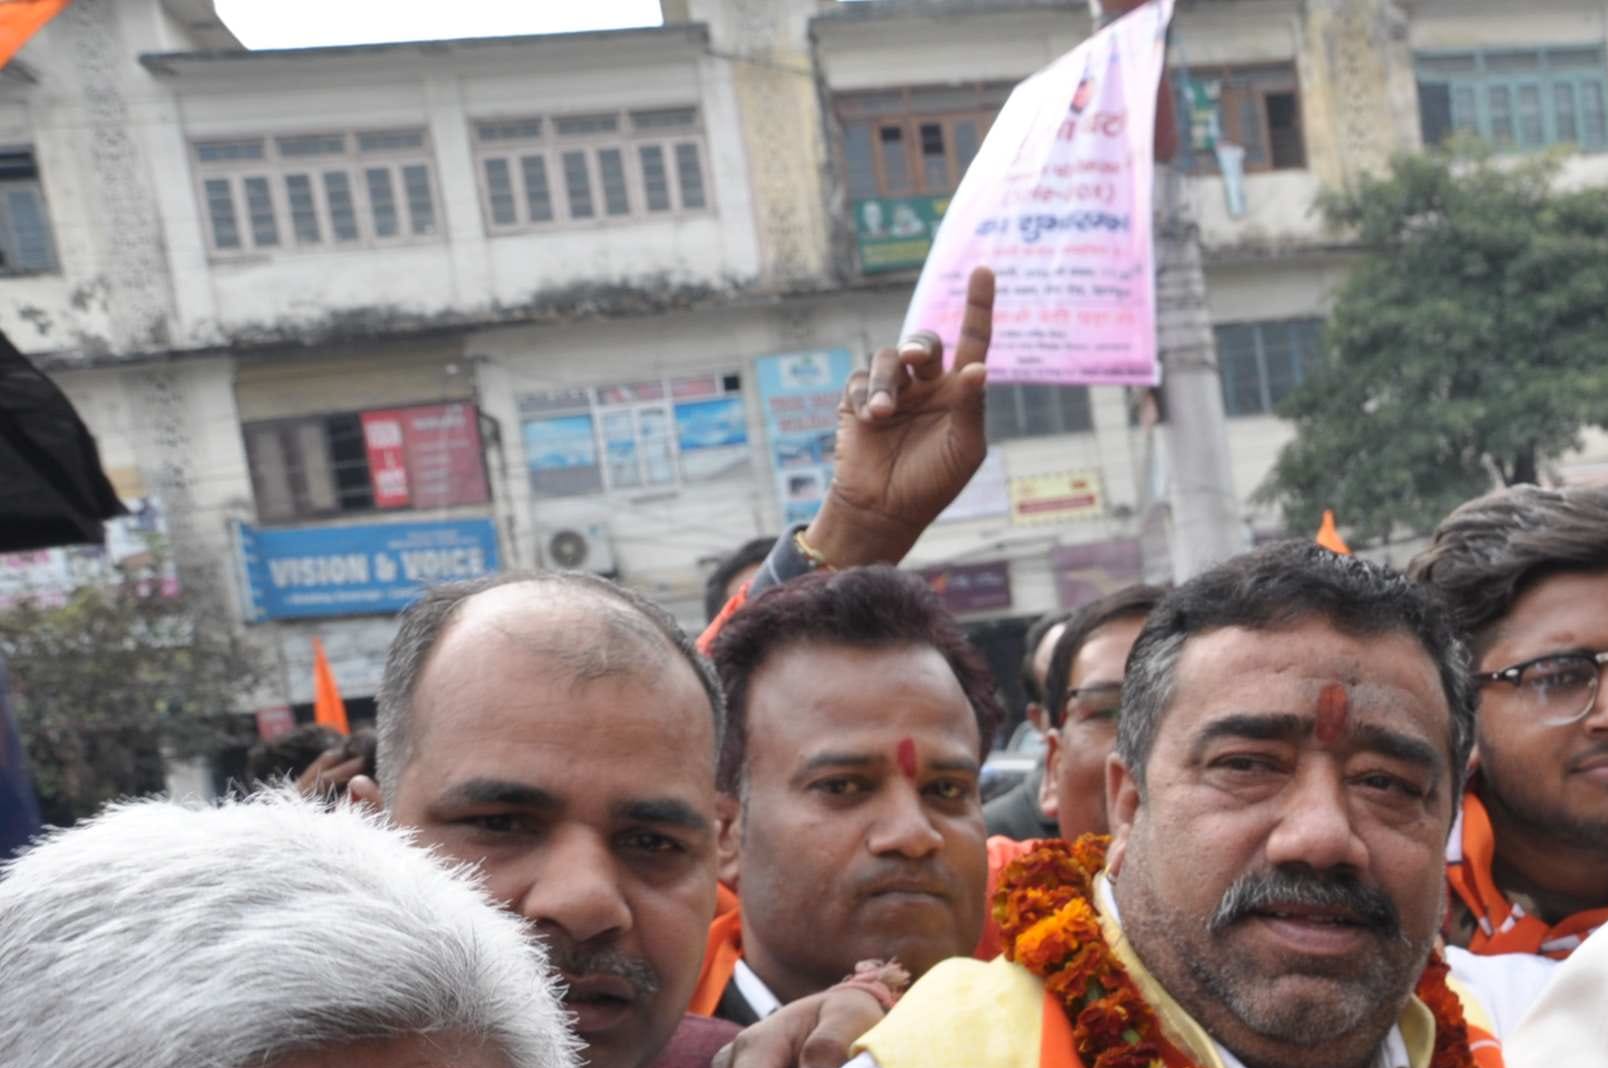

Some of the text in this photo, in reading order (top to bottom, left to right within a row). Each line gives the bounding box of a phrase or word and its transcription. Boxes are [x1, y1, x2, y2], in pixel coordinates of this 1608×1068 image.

[269, 545, 485, 588] VISION & VOICE
